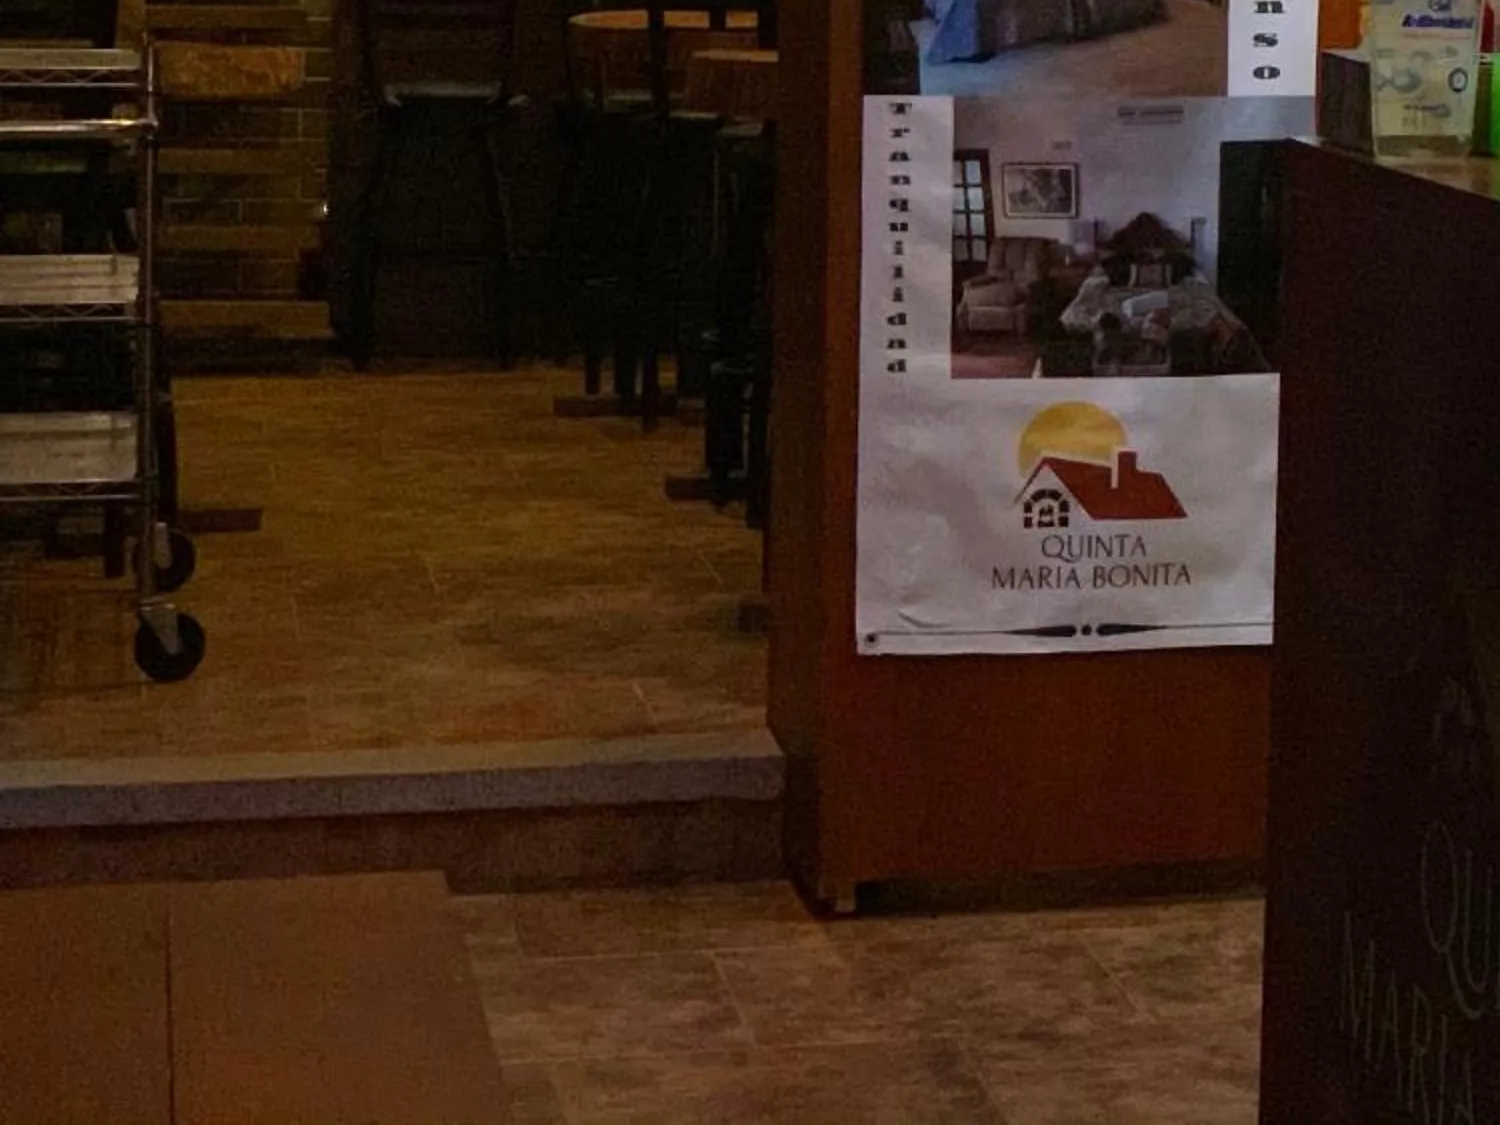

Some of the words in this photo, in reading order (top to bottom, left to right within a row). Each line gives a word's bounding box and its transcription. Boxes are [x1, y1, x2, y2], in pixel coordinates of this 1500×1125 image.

[886, 102, 912, 374] Tranquilidad
[1041, 533, 1147, 563] QUINTA
[992, 565, 1082, 589] MARIA
[1092, 562, 1192, 588] BONITA
